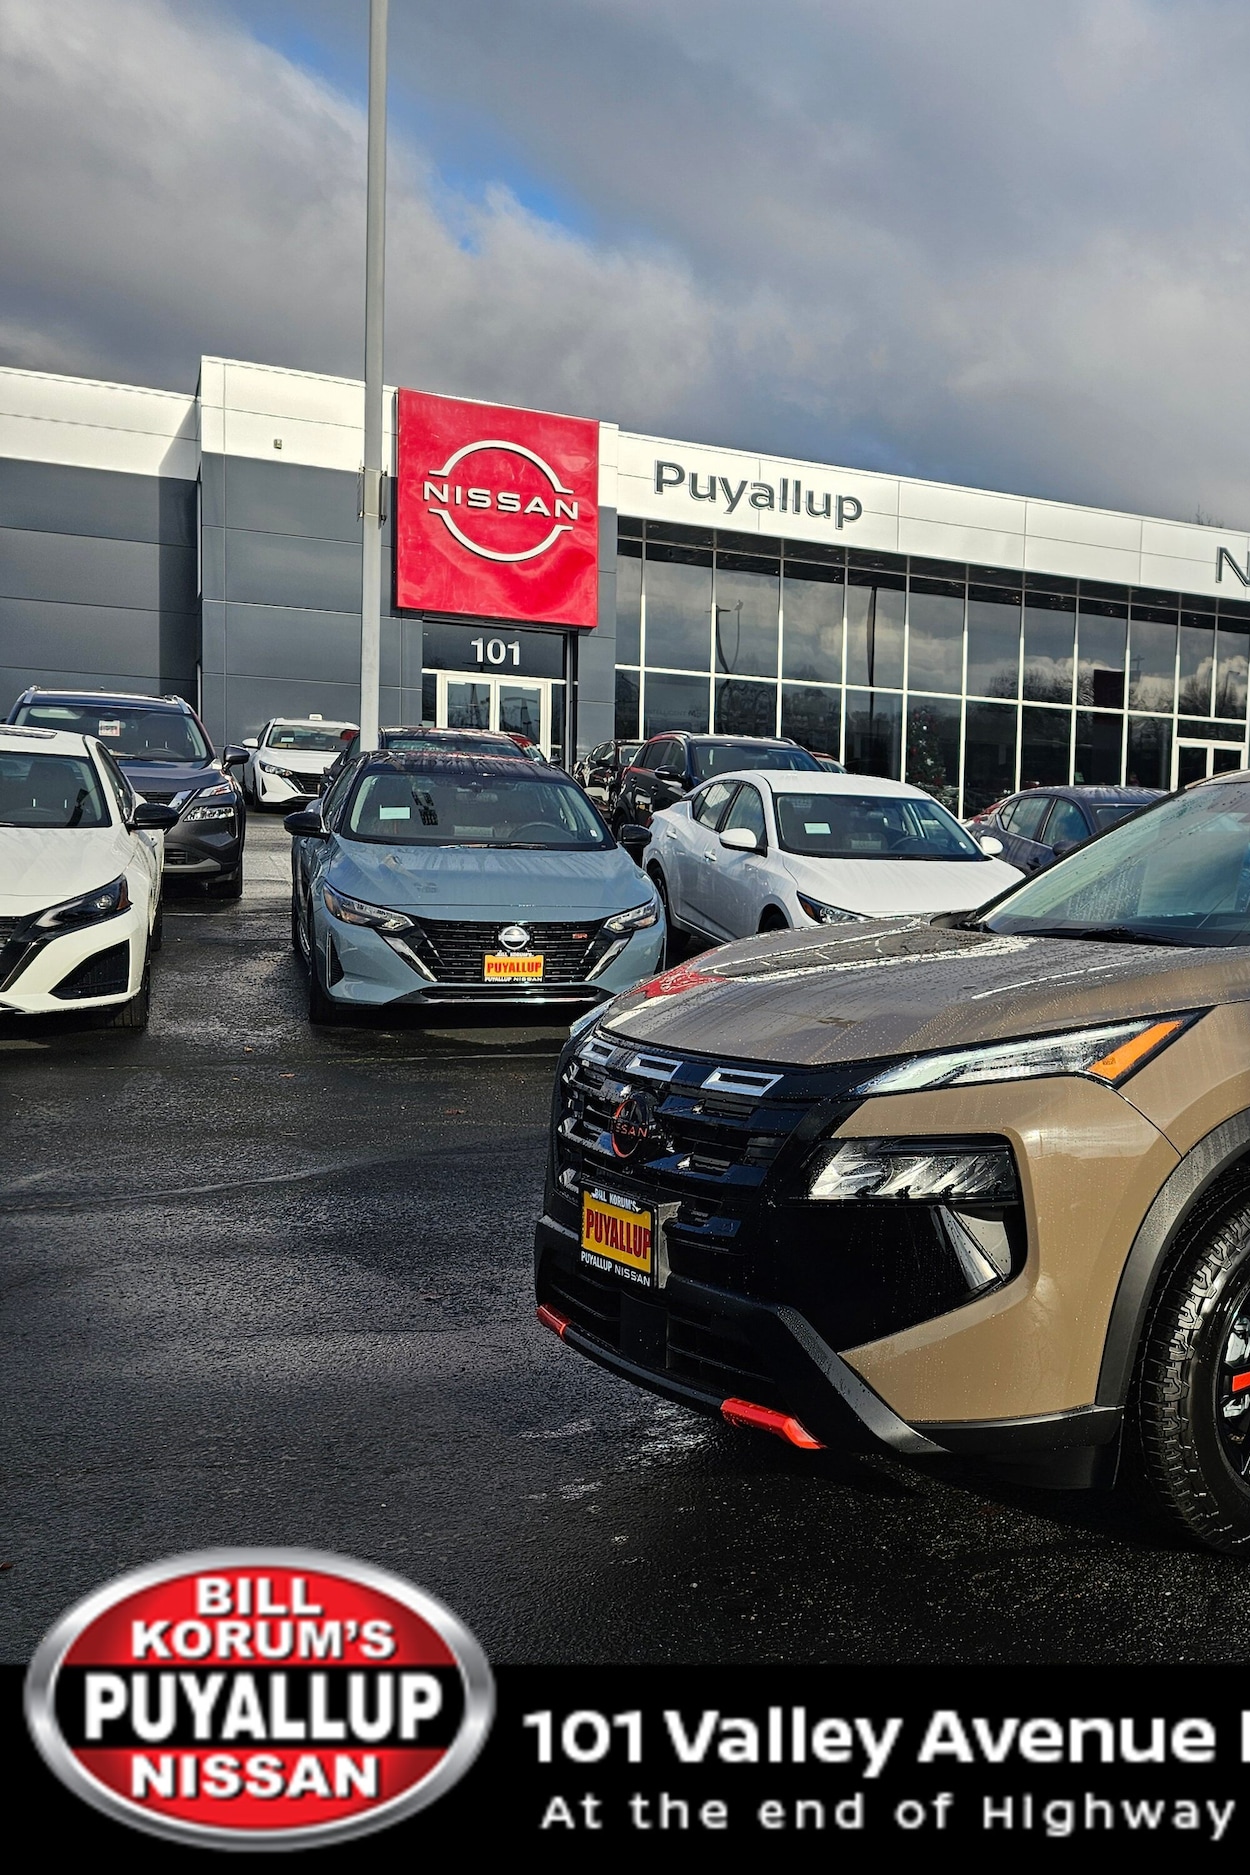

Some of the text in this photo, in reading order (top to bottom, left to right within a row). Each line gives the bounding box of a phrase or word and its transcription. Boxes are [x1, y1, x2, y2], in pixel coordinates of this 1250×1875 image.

[423, 480, 579, 520] NISSAN
[653, 459, 863, 530] Puyallup
[471, 637, 521, 667] 101
[487, 962, 542, 973] PUYALLUP
[585, 1208, 650, 1260] PUYALLUP
[580, 1250, 651, 1287] PUYALLUP NISSAN
